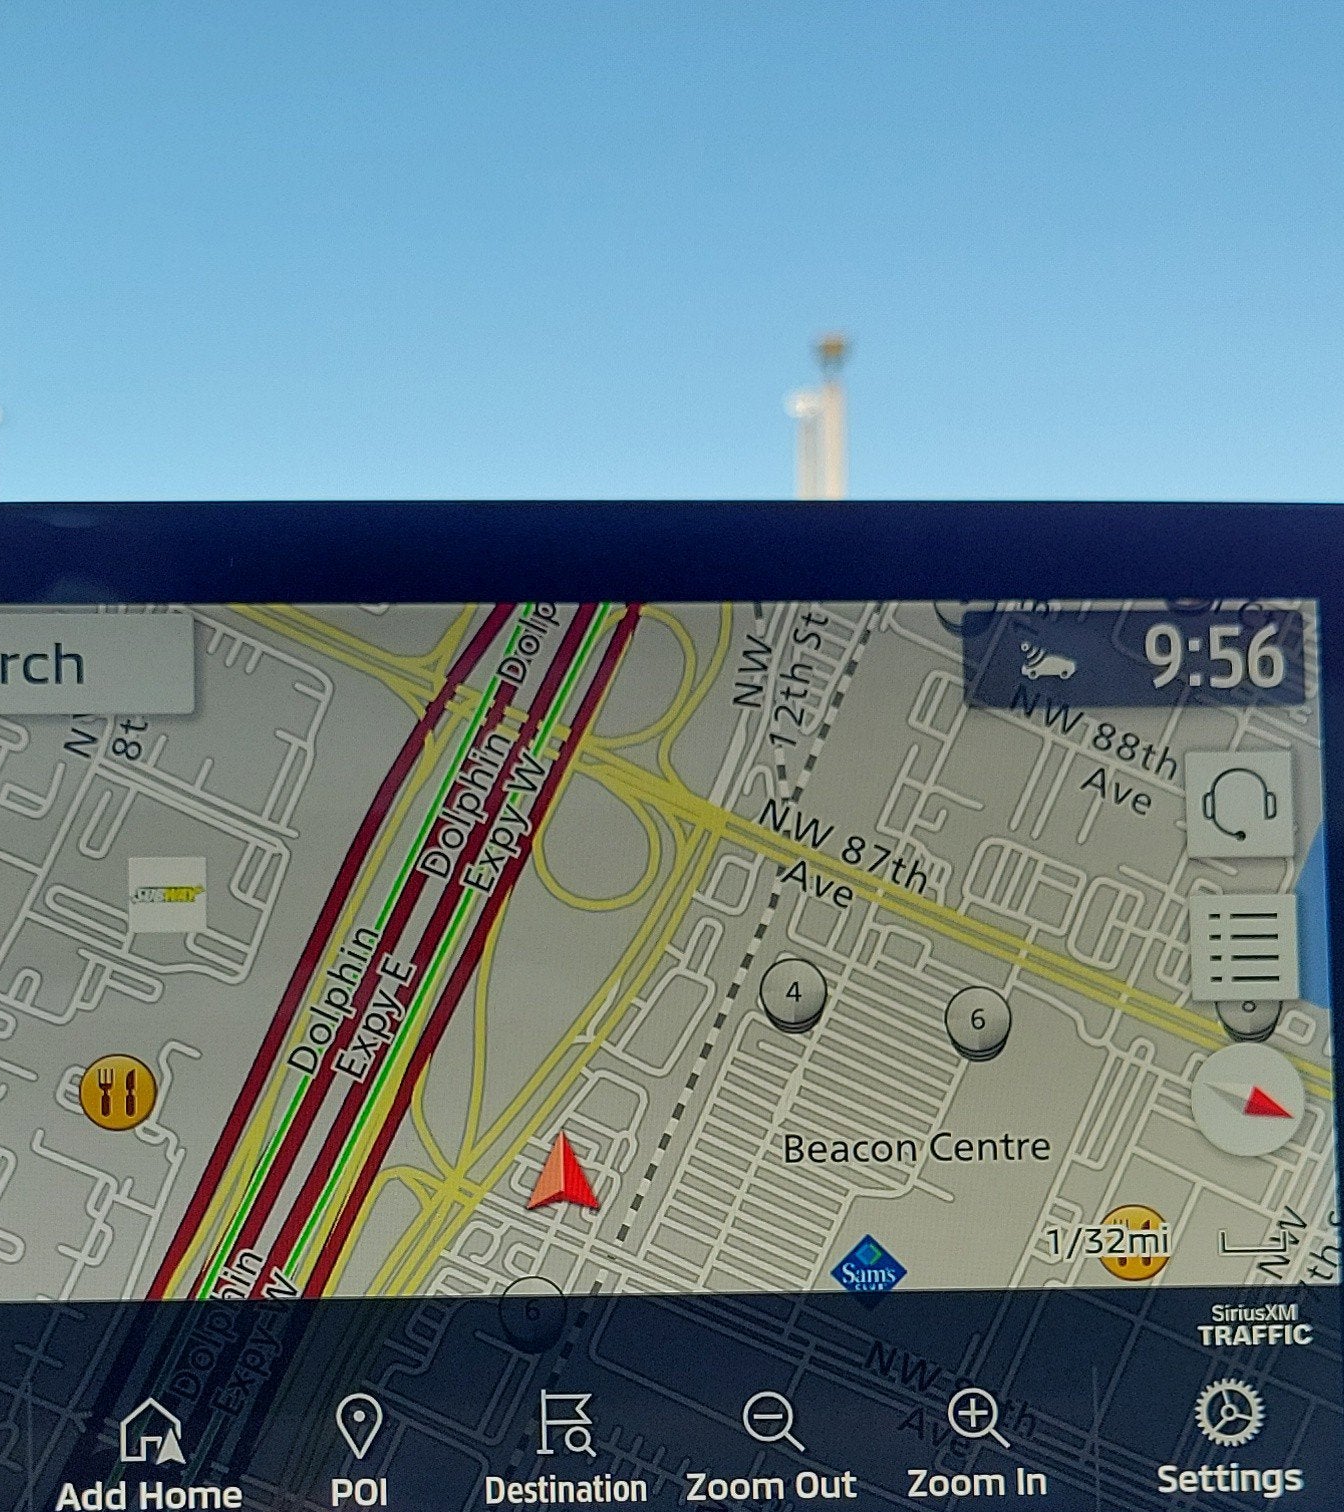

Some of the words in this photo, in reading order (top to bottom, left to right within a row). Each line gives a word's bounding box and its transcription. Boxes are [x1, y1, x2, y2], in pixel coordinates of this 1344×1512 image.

[733, 634, 773, 707] NW
[1144, 622, 1286, 689] 9:56
[769, 663, 814, 747] 12th
[793, 612, 829, 650] St
[63, 713, 98, 758] N
[1009, 683, 1085, 735] NW
[1092, 722, 1178, 780] 88th
[421, 734, 511, 878] Dolphin
[1079, 767, 1152, 815] Ave
[465, 801, 530, 892] Expy
[506, 751, 547, 794] W
[758, 799, 835, 849] NW
[841, 836, 927, 894] 87th
[780, 860, 854, 908] Ave
[287, 928, 379, 1074] Dolphin
[785, 981, 802, 1002] 4
[335, 989, 402, 1079] Expy
[381, 957, 413, 983] E
[970, 1008, 986, 1031] 6
[783, 1134, 917, 1164] Beacon
[929, 1132, 1051, 1161] Centre
[1046, 1225, 1168, 1260] 1/32mi
[1211, 1303, 1299, 1322] SiriusXM
[1197, 1323, 1314, 1346] TRAFFIC
[55, 1483, 126, 1512] Add
[139, 1481, 243, 1510] Home
[331, 1477, 387, 1506] POI
[485, 1474, 647, 1505] Destination
[686, 1473, 784, 1501] Zoom
[795, 1471, 857, 1499] Out
[908, 1469, 1005, 1498] Zoom
[1017, 1468, 1047, 1496] In
[1157, 1465, 1303, 1498] Settings
